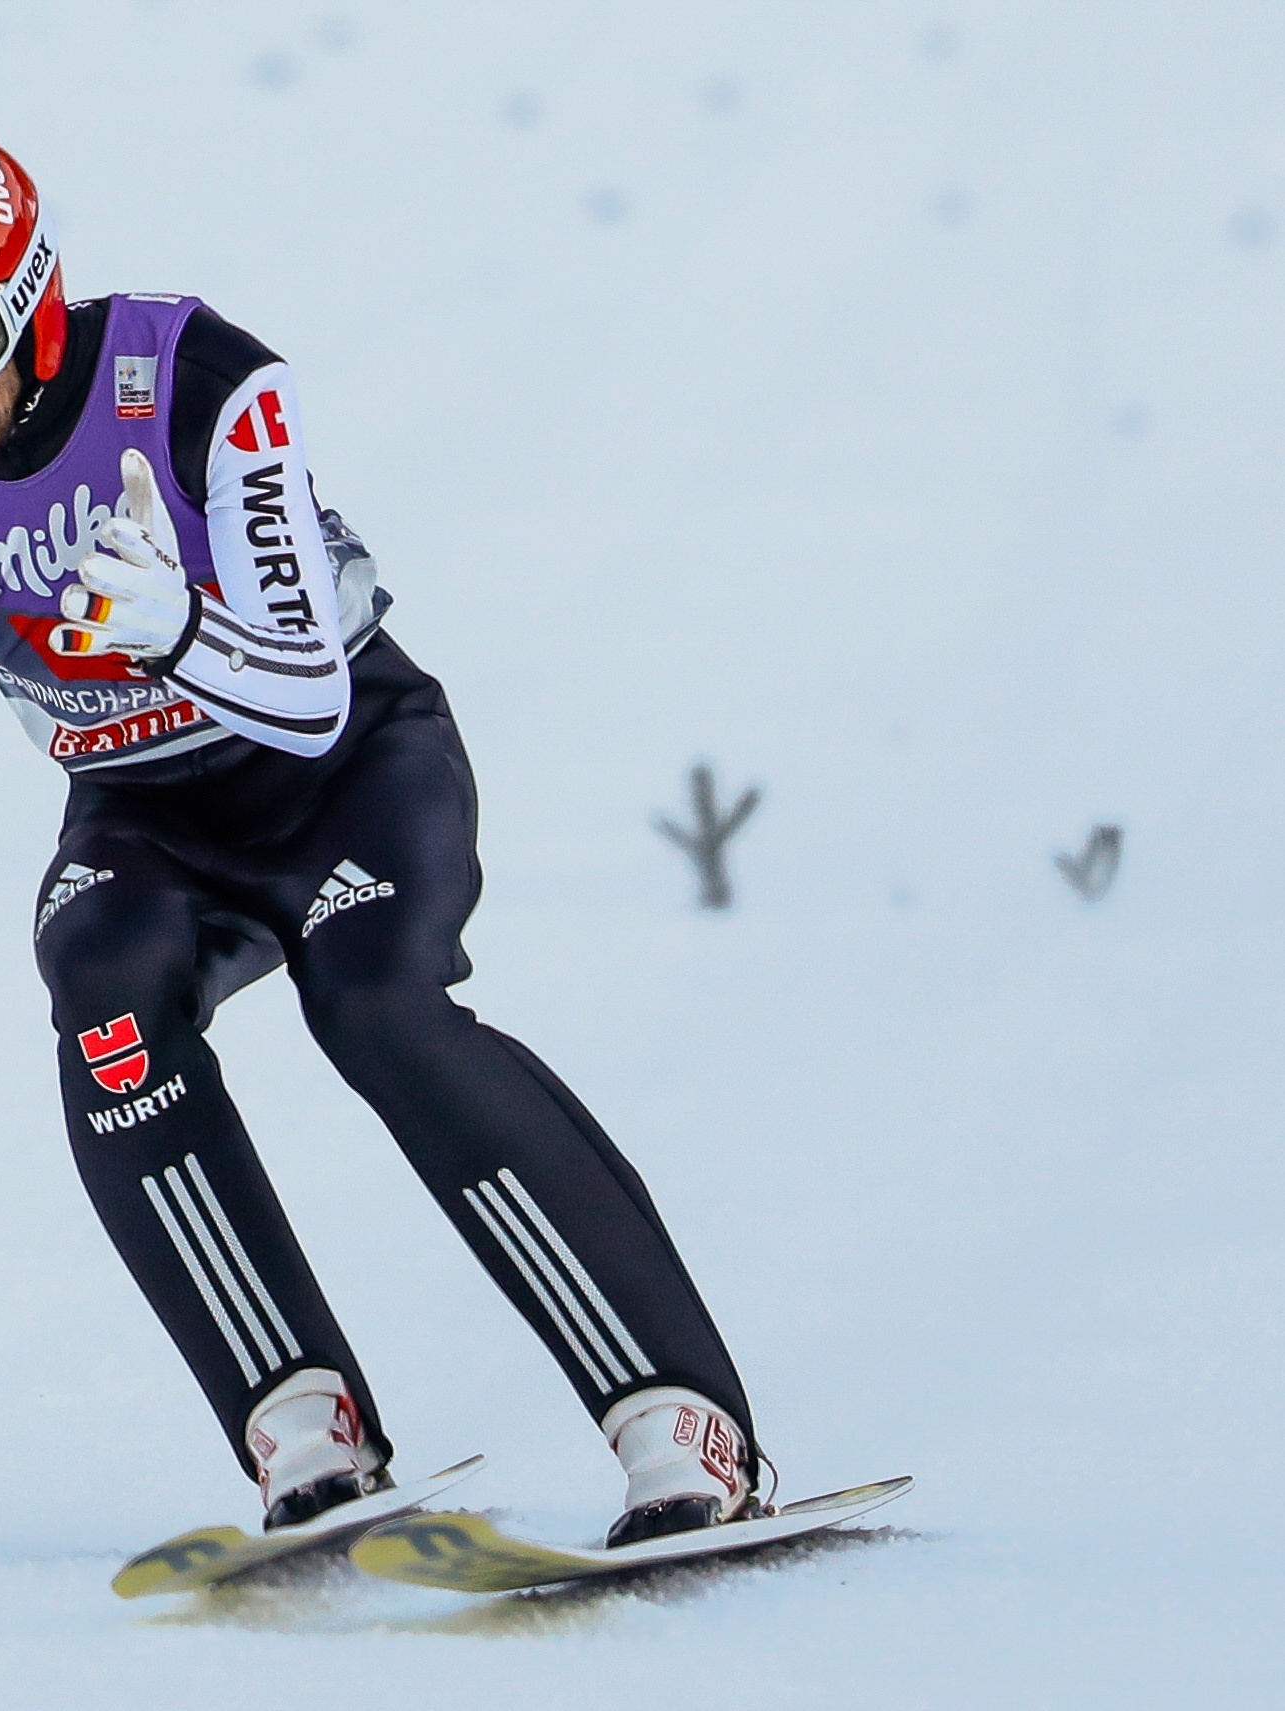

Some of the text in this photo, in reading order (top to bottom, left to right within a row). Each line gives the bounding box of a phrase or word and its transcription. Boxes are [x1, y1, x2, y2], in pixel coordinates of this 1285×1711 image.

[10, 234, 53, 317] uvex
[35, 868, 115, 942] adidas
[301, 880, 396, 939] adidas
[86, 1073, 188, 1136] WÜRTH
